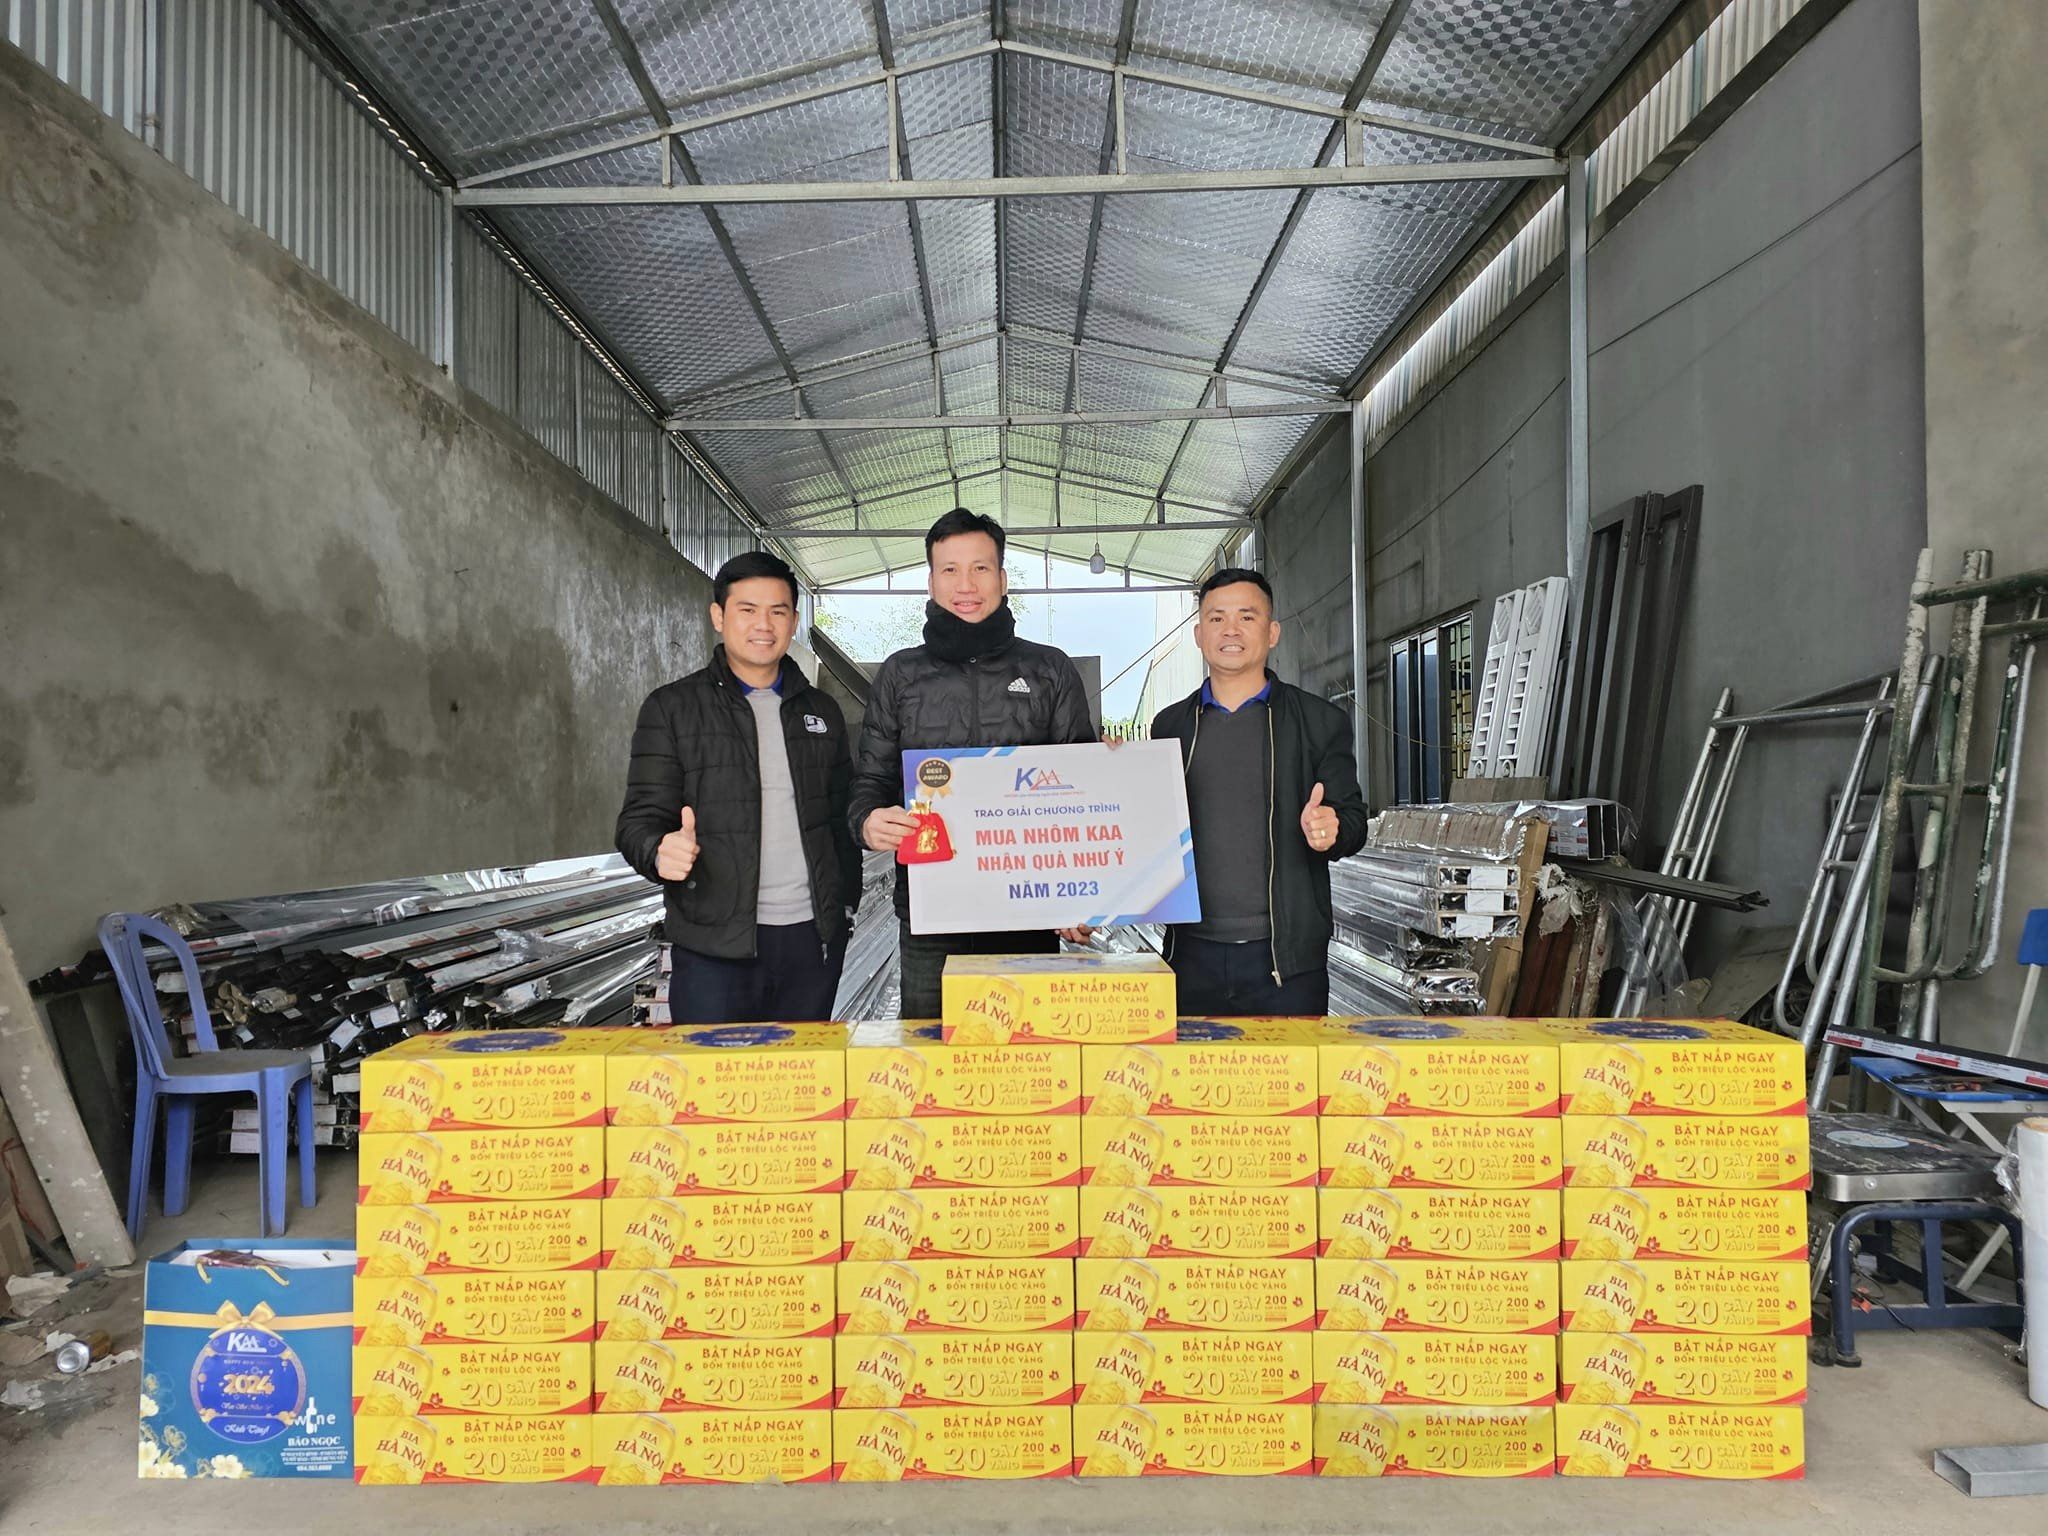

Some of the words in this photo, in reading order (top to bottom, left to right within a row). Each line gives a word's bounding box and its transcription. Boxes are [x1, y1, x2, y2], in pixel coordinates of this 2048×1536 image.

[974, 808, 1004, 818] TRAO
[1007, 804, 1031, 816] GIẢI
[1034, 804, 1085, 816] CHƯƠNG
[1088, 801, 1120, 813] TRÌNH
[976, 829, 1017, 846] MUA
[1023, 824, 1080, 844] NHÔM
[1086, 824, 1123, 842] KAA
[977, 852, 1026, 874] NHẬN
[1073, 849, 1110, 868] NHƯ
[1114, 847, 1124, 865] Ý
[1009, 880, 1050, 899] NĂM
[1056, 881, 1099, 897] 2023
[1080, 977, 1108, 993] NẮP
[1112, 982, 1149, 992] NGAY
[988, 989, 1007, 1005] BIA
[965, 999, 987, 1015] HÀ
[989, 1005, 1014, 1031] NỘI
[1127, 1008, 1149, 1018] 200
[1050, 1009, 1091, 1036] 20
[1703, 1047, 1732, 1063] NẮP
[1737, 1053, 1775, 1063] NGAY
[504, 1060, 533, 1076] NẮP
[537, 1064, 575, 1075] NGAY
[1607, 1059, 1627, 1074] BIA
[407, 1075, 426, 1091] BIA
[1583, 1068, 1606, 1084] HÀ
[1608, 1075, 1635, 1100] NỘI
[1753, 1079, 1776, 1088] 200
[553, 1090, 575, 1100] 200
[1672, 1079, 1716, 1106] 20
[382, 1085, 406, 1102] HÀ
[407, 1091, 434, 1117] NỘI
[472, 1092, 515, 1121] 20
[983, 1120, 1010, 1136] NẮP
[1015, 1124, 1051, 1135] NGAY
[890, 1133, 909, 1148] BIA
[867, 1142, 889, 1159] HÀ
[890, 1149, 916, 1174] NỘI
[1030, 1151, 1051, 1160] 200
[953, 1152, 994, 1179] 20
[1220, 1190, 1247, 1206] NẮP
[1252, 1196, 1289, 1206] NGAY
[1126, 1202, 1145, 1216] BIA
[1102, 1210, 1125, 1227] HÀ
[1127, 1217, 1152, 1243] NỘI
[1268, 1222, 1289, 1231] 200
[1189, 1222, 1231, 1249] 20
[735, 1270, 763, 1286] NẮP
[768, 1275, 805, 1286] NGAY
[1457, 1264, 1486, 1280] NẮP
[1490, 1270, 1528, 1281] NGAY
[1361, 1275, 1380, 1290] BIA
[641, 1284, 660, 1300] BIA
[1337, 1283, 1360, 1300] HÀ
[1362, 1291, 1388, 1317] NỘI
[617, 1294, 640, 1311] HÀ
[641, 1300, 667, 1326] NỘI
[783, 1302, 805, 1312] 200
[1426, 1296, 1469, 1324] 20
[1506, 1297, 1529, 1307] 200
[704, 1303, 746, 1331] 20
[223, 1374, 272, 1394] 2024
[495, 1418, 523, 1433] NẮP
[527, 1422, 564, 1432] NGAY
[1700, 1410, 1729, 1426] NẮP
[1734, 1416, 1773, 1426] NGAY
[1603, 1420, 1622, 1436] BIA
[311, 1436, 341, 1446] NGỌC
[400, 1430, 420, 1445] BIA
[543, 1447, 565, 1457] 200
[1578, 1429, 1602, 1446] HÀ
[1603, 1436, 1630, 1463] NỘI
[1751, 1443, 1773, 1453] 200
[375, 1439, 399, 1456] HÀ
[400, 1446, 427, 1471] NỘI
[464, 1448, 506, 1476] 20
[1669, 1442, 1713, 1470] 20
